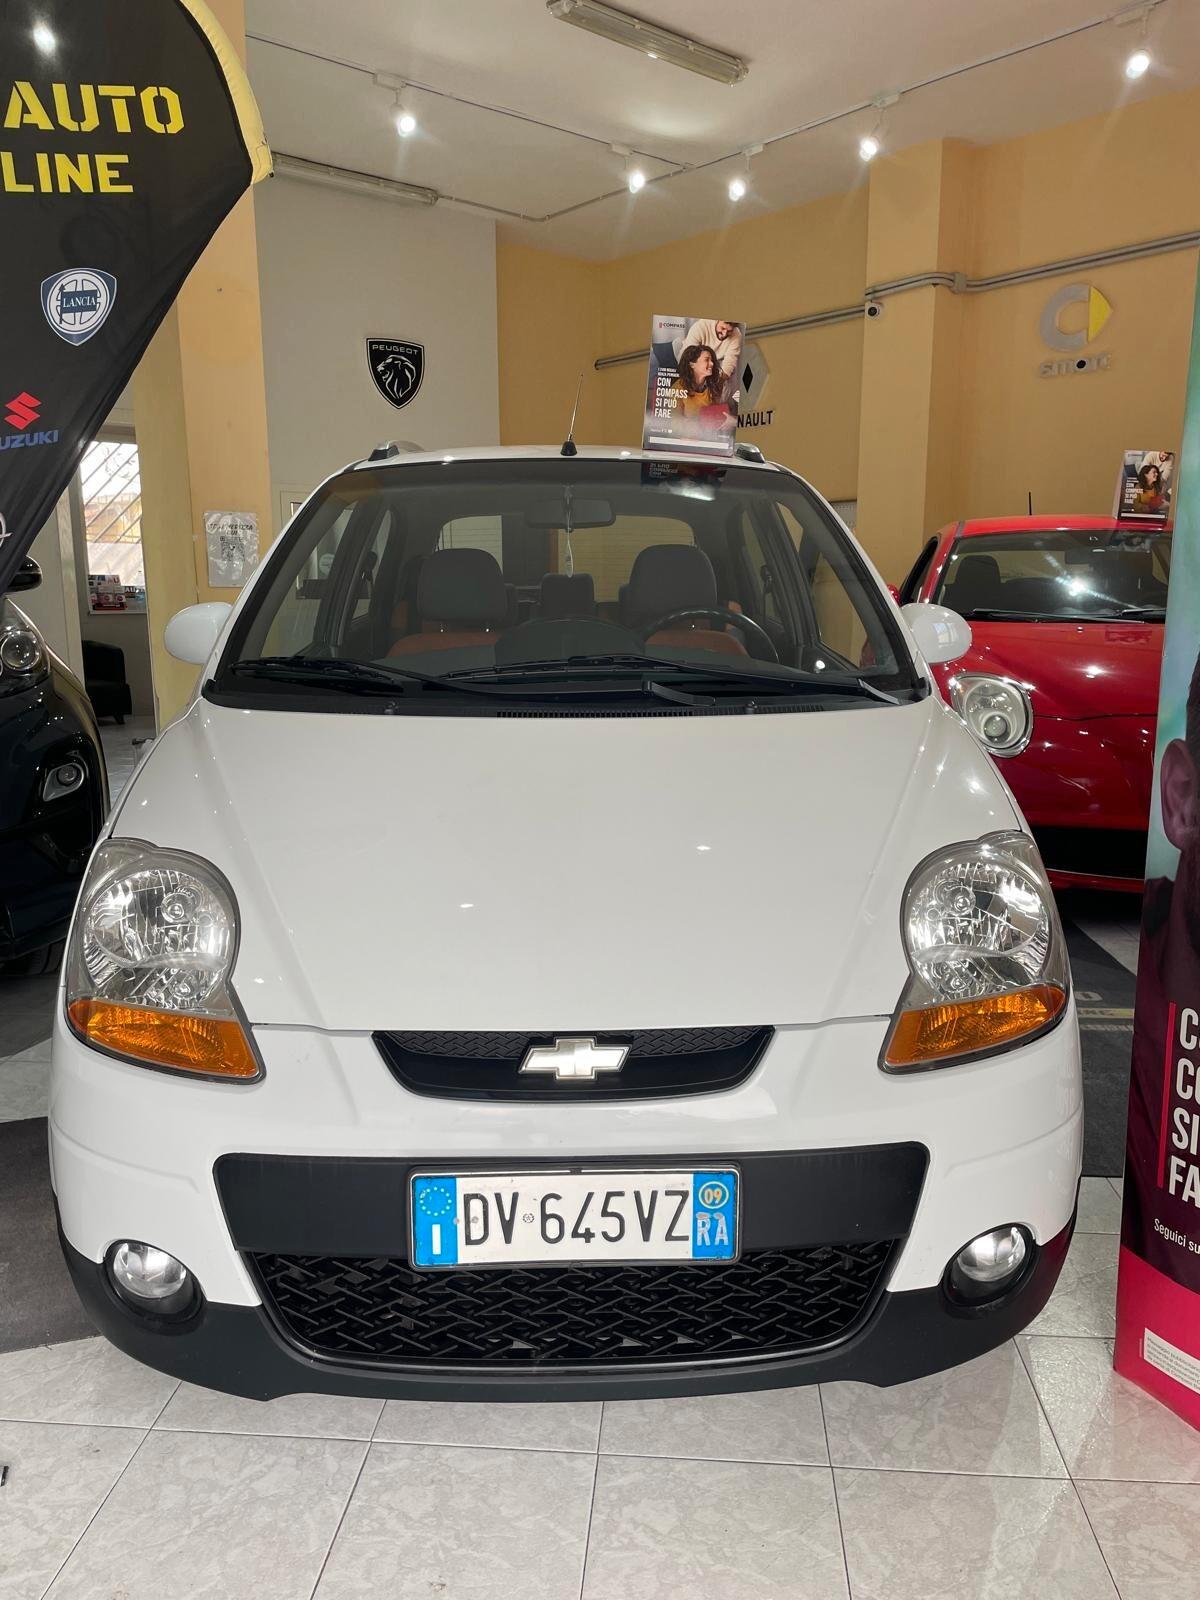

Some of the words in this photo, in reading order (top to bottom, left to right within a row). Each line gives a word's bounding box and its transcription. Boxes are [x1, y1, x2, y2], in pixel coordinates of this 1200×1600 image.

[4, 81, 184, 134] AUTO
[0, 151, 134, 193] LINE
[62, 295, 97, 308] LANCIA
[372, 344, 419, 355] PEUGEOT
[1039, 353, 1111, 377] smart
[657, 377, 672, 387] CON
[656, 387, 689, 399] COMPASS
[655, 397, 663, 408] SI
[663, 397, 678, 409] PUÒ
[654, 408, 672, 419] FARE
[704, 1188, 722, 1204] 09
[463, 1192, 519, 1246] DV
[540, 1190, 690, 1244] 645VZ
[696, 1212, 729, 1246] RA
[1153, 1218, 1187, 1247] Seguici
